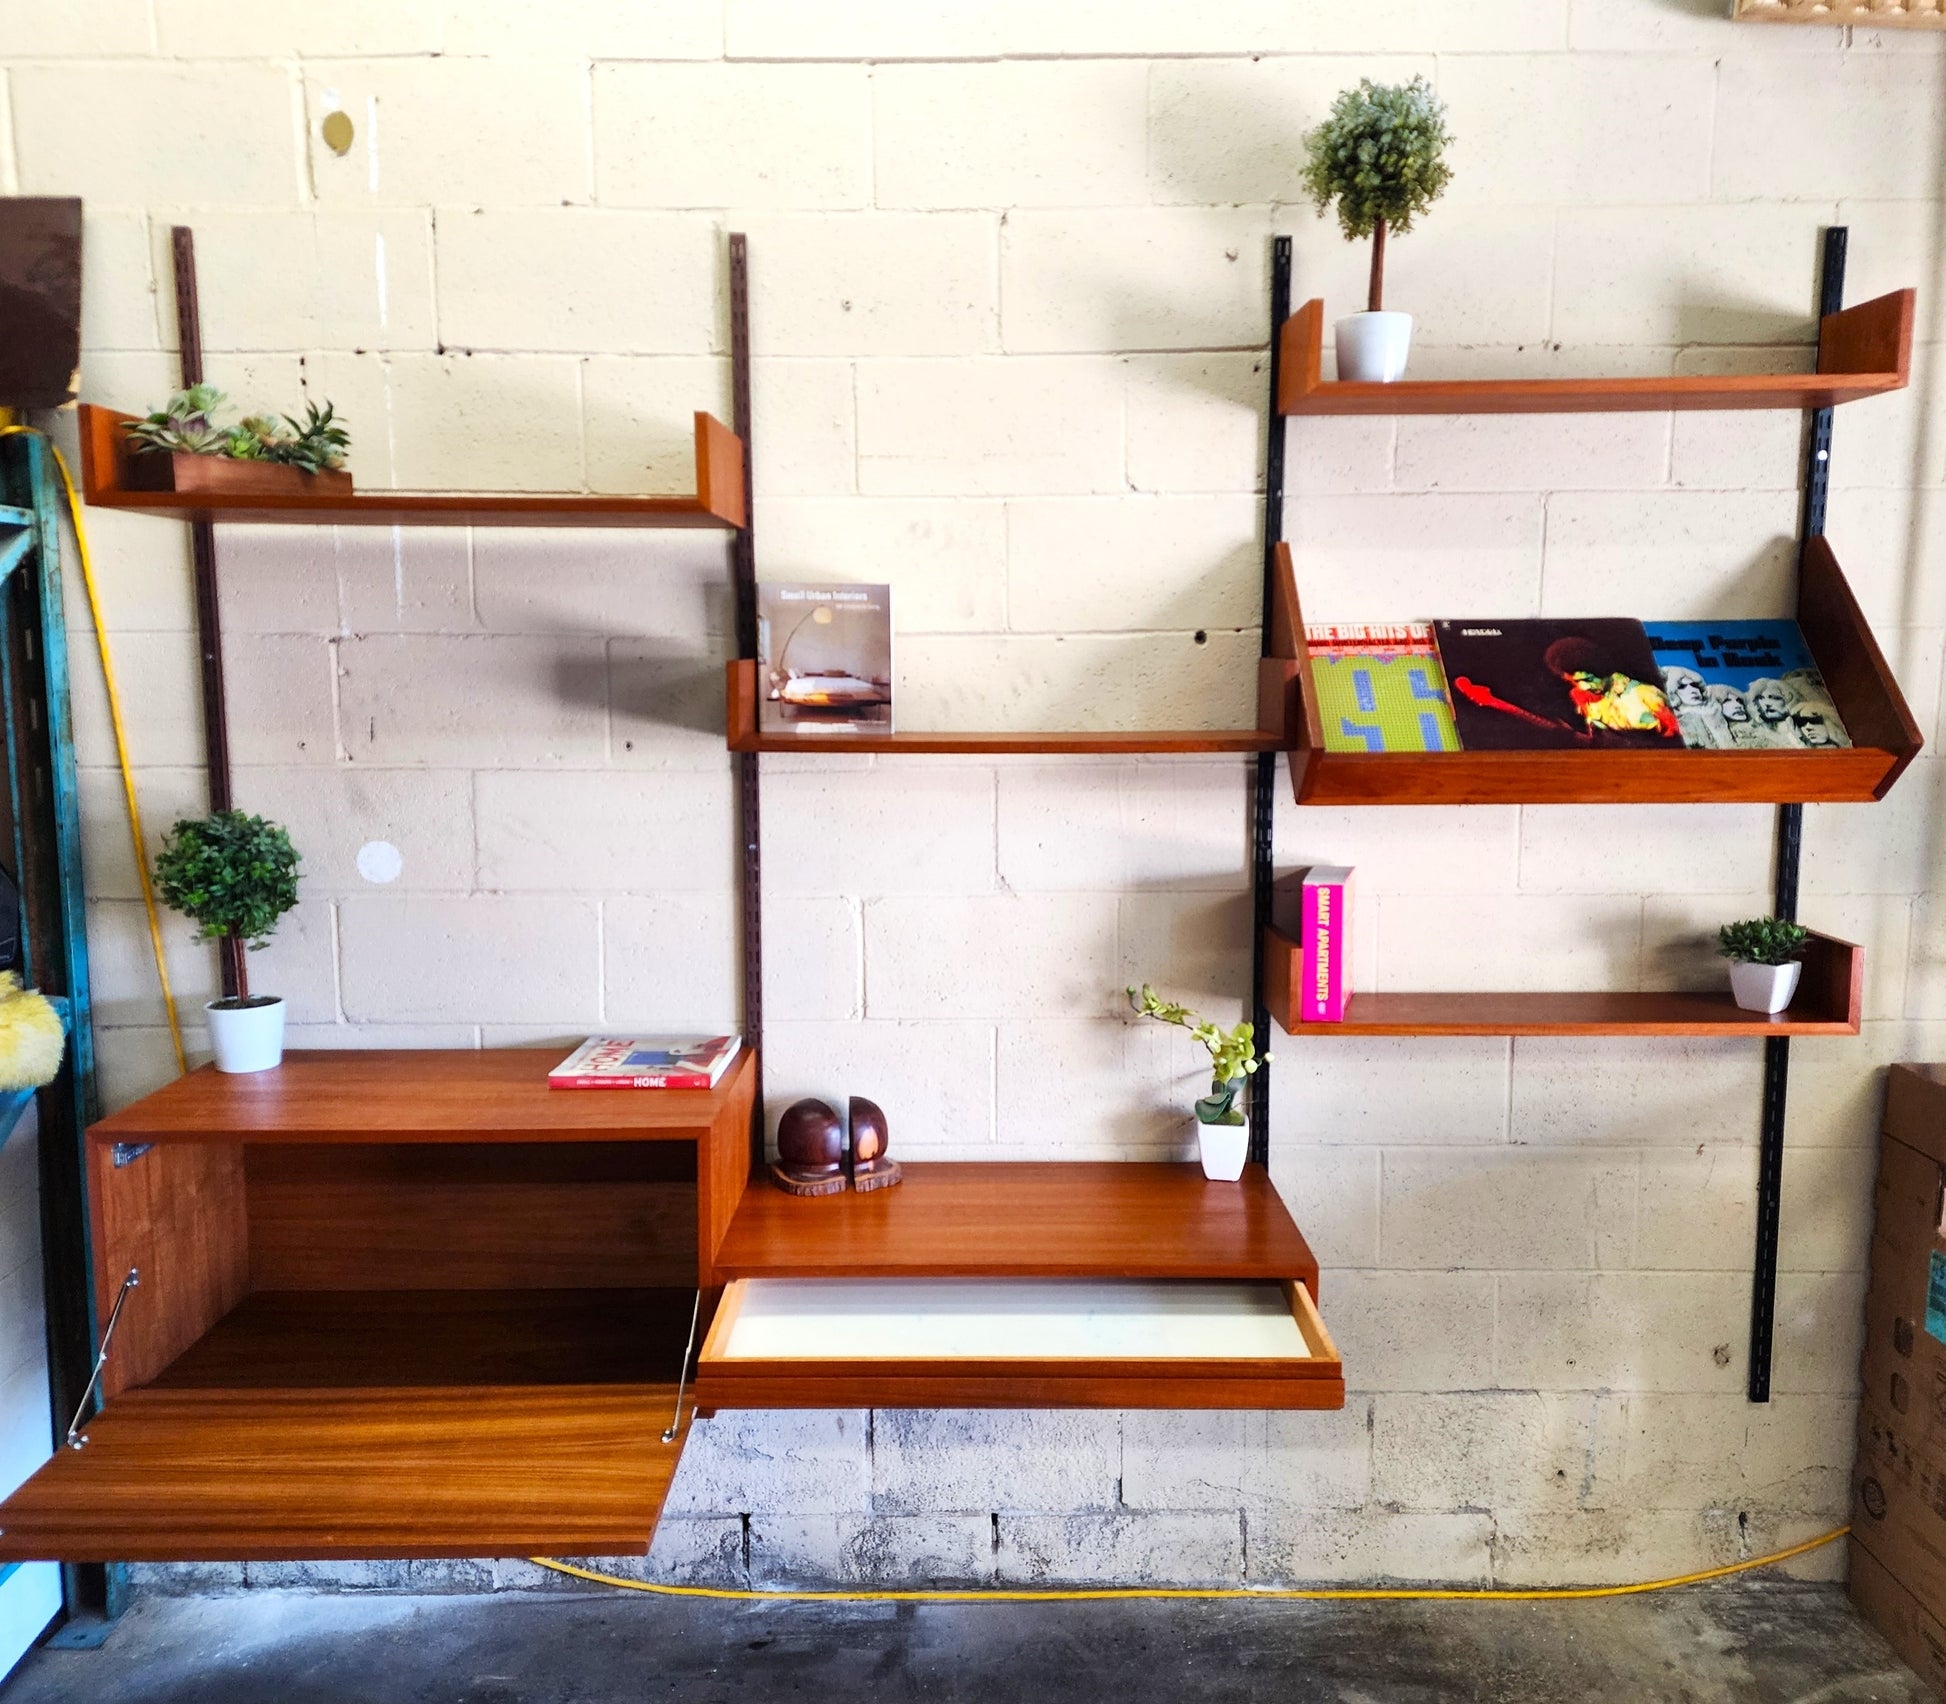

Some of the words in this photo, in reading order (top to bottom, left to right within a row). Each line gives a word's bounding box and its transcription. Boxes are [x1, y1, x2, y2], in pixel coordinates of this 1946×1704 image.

[781, 590, 804, 600] Small
[806, 590, 831, 600] Urban
[832, 590, 867, 600] Interiors
[1303, 623, 1335, 640] THE
[1337, 623, 1367, 640] BIG
[1369, 623, 1408, 639] HITS
[1409, 623, 1430, 638] OF
[1648, 636, 1707, 653] Deep
[1708, 635, 1782, 652] Purple
[1722, 652, 1784, 668] Rock
[1317, 887, 1330, 926] SMART
[1315, 928, 1330, 1001] APARTMENTS
[580, 1040, 636, 1070] HOME
[633, 1077, 667, 1087] HOME
